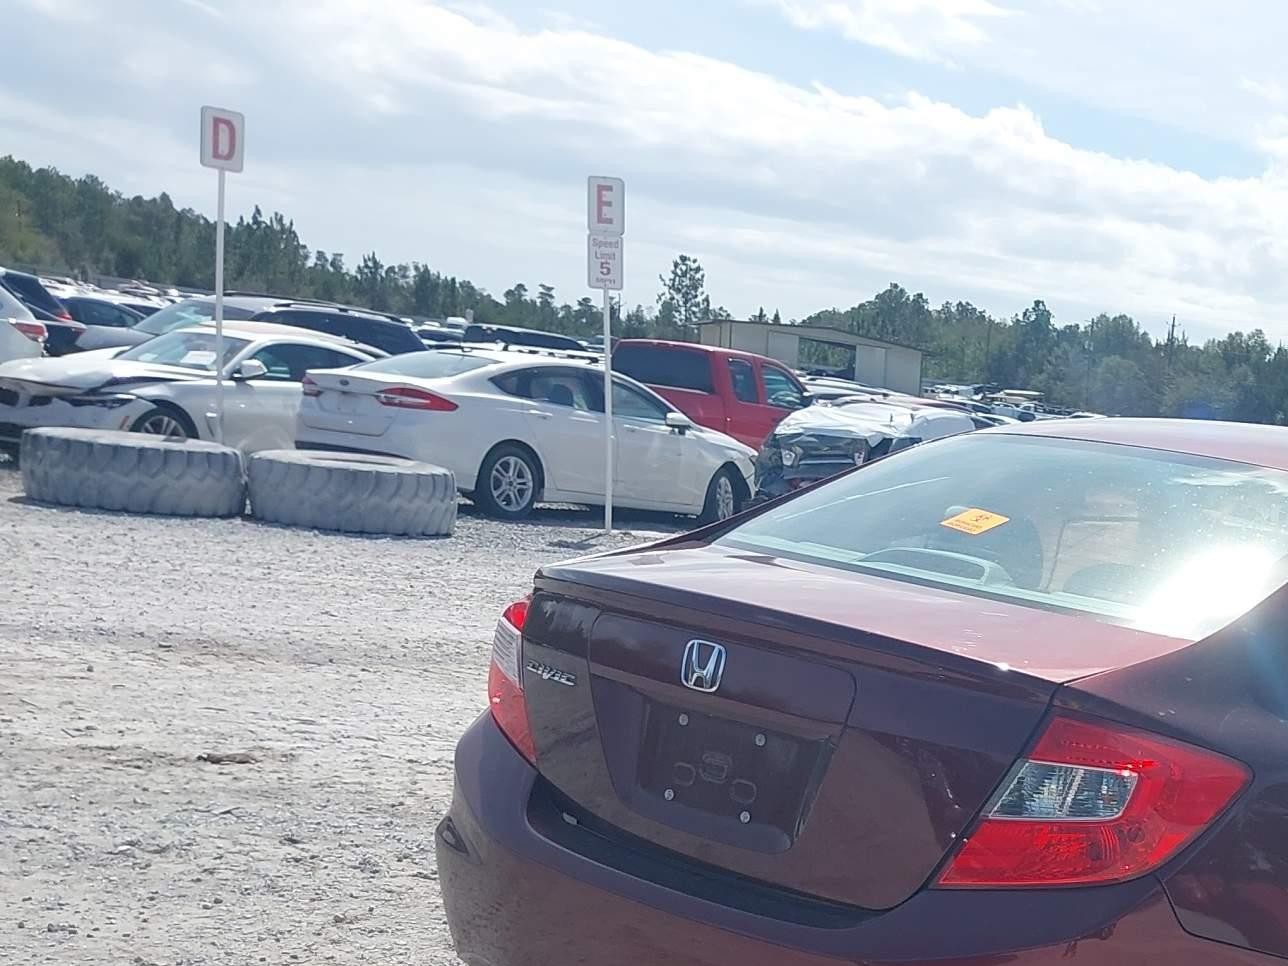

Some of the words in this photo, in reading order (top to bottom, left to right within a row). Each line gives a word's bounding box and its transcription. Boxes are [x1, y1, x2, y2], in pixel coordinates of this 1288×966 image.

[212, 116, 236, 161] D
[596, 184, 614, 224] E
[592, 238, 619, 249] Speed
[600, 261, 611, 276] 5
